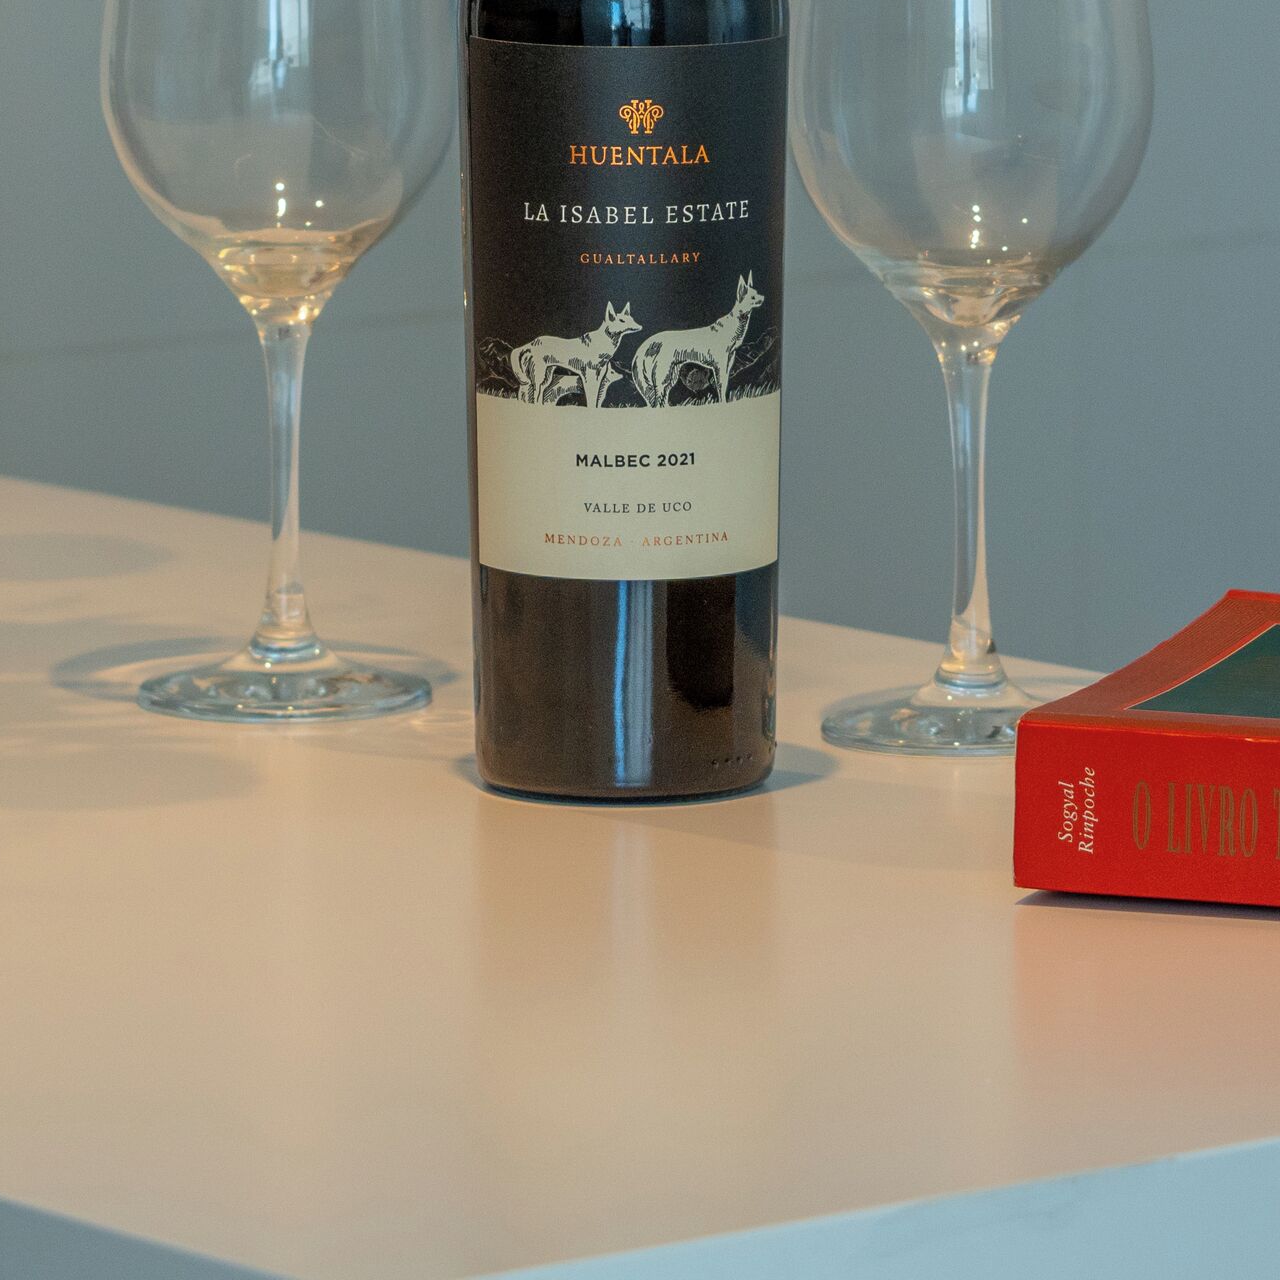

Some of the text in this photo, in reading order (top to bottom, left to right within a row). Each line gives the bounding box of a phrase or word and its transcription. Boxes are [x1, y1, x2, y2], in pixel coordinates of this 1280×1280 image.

[569, 144, 711, 166] HUENTALA
[523, 200, 750, 225] LA ISABEL ESTATE
[579, 252, 702, 265] GUALTALLARY
[575, 452, 696, 468] MALBEC 2021
[583, 501, 693, 514] VALLE DE UCO
[544, 531, 729, 547] MENDOZA ARGENTINA
[1057, 780, 1078, 843] Sogyal
[1078, 766, 1099, 855] Rinpoche
[1131, 779, 1152, 850] O
[1167, 781, 1259, 858] LIVRO
